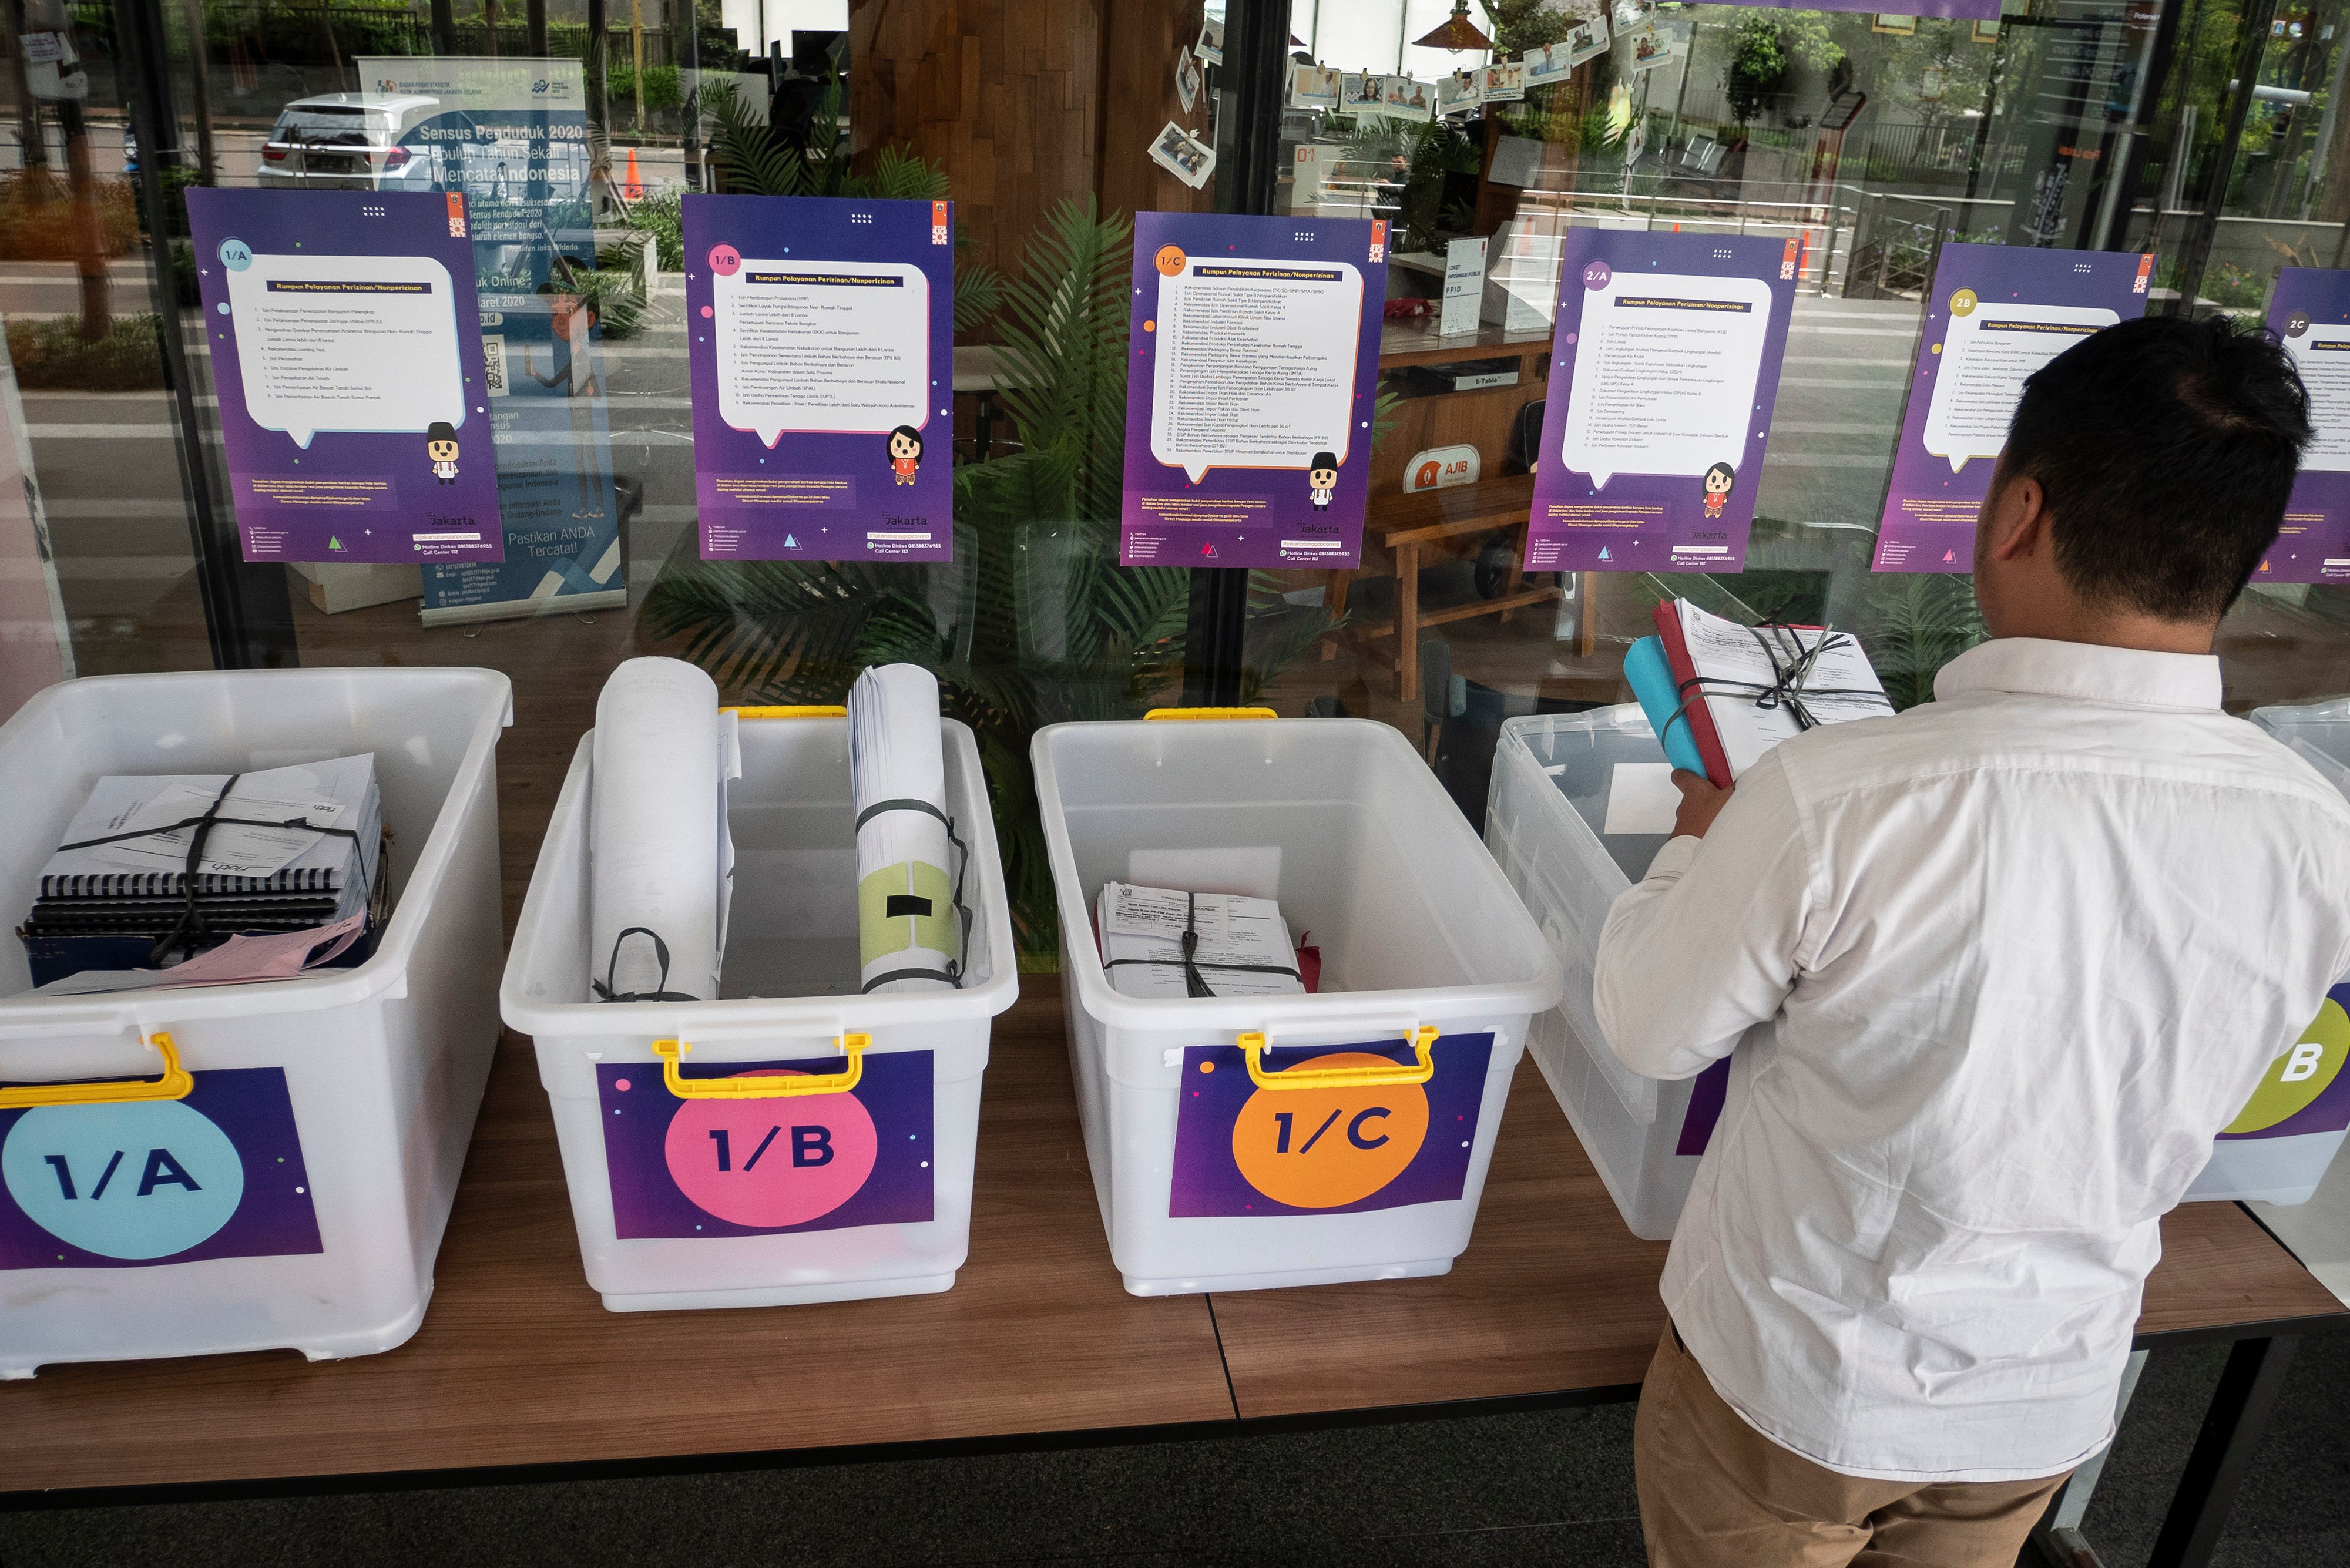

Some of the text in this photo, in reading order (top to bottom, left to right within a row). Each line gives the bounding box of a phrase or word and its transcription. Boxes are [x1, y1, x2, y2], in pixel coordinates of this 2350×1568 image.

[421, 125, 583, 140] Sensus Penduduk 2020
[479, 146, 519, 160] Tahun
[522, 146, 559, 160] Sekali
[1297, 147, 1315, 162] 01
[492, 210, 525, 219] Penduduk
[526, 209, 542, 217] 2020
[226, 251, 247, 261] 1/A
[715, 256, 735, 265] 1/B
[1161, 257, 1180, 266] 1/C
[1262, 270, 1334, 278] Perizinan/Nonperizinan
[1586, 271, 1607, 282] 2/A
[491, 276, 525, 287] Online
[1446, 286, 1461, 294] PPID
[478, 296, 525, 308] aret 2020
[1677, 301, 1744, 310] Perizinan/Nonperizinan
[2036, 325, 2097, 333] Perizinan/Nonperizinan
[492, 434, 512, 444] 020
[1445, 461, 1468, 475] AJIB
[509, 526, 595, 545] Pastikan ANDA
[528, 542, 578, 558] Tercatat!
[1275, 1107, 1391, 1154] 1/C
[709, 1125, 834, 1172] 1/B
[43, 1148, 203, 1201] 1/A
